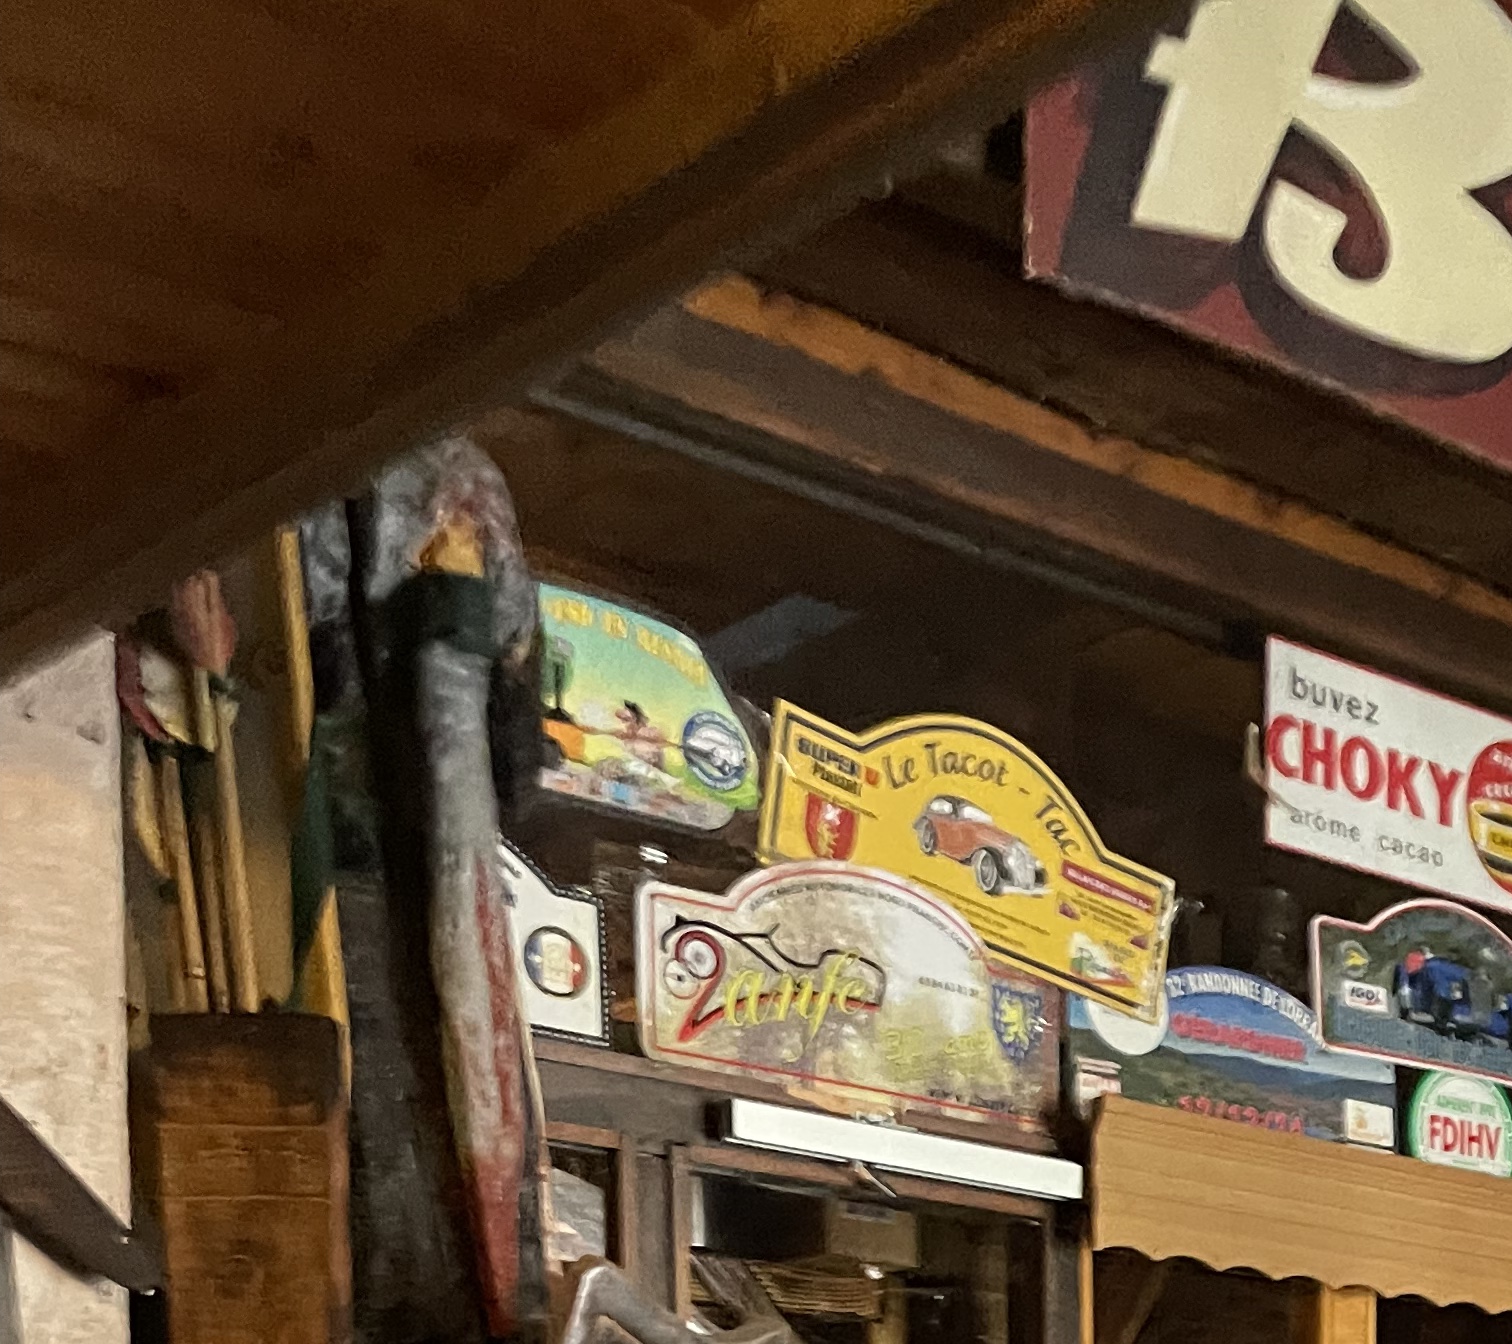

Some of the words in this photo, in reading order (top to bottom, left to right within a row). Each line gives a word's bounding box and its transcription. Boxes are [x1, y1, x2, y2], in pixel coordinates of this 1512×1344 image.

[1290, 665, 1380, 725] buvez
[881, 755, 919, 790] Le
[923, 740, 1009, 789] Tacot
[1035, 795, 1081, 860] Tac
[1266, 713, 1467, 828] CHOKY
[1378, 832, 1445, 868] cacao
